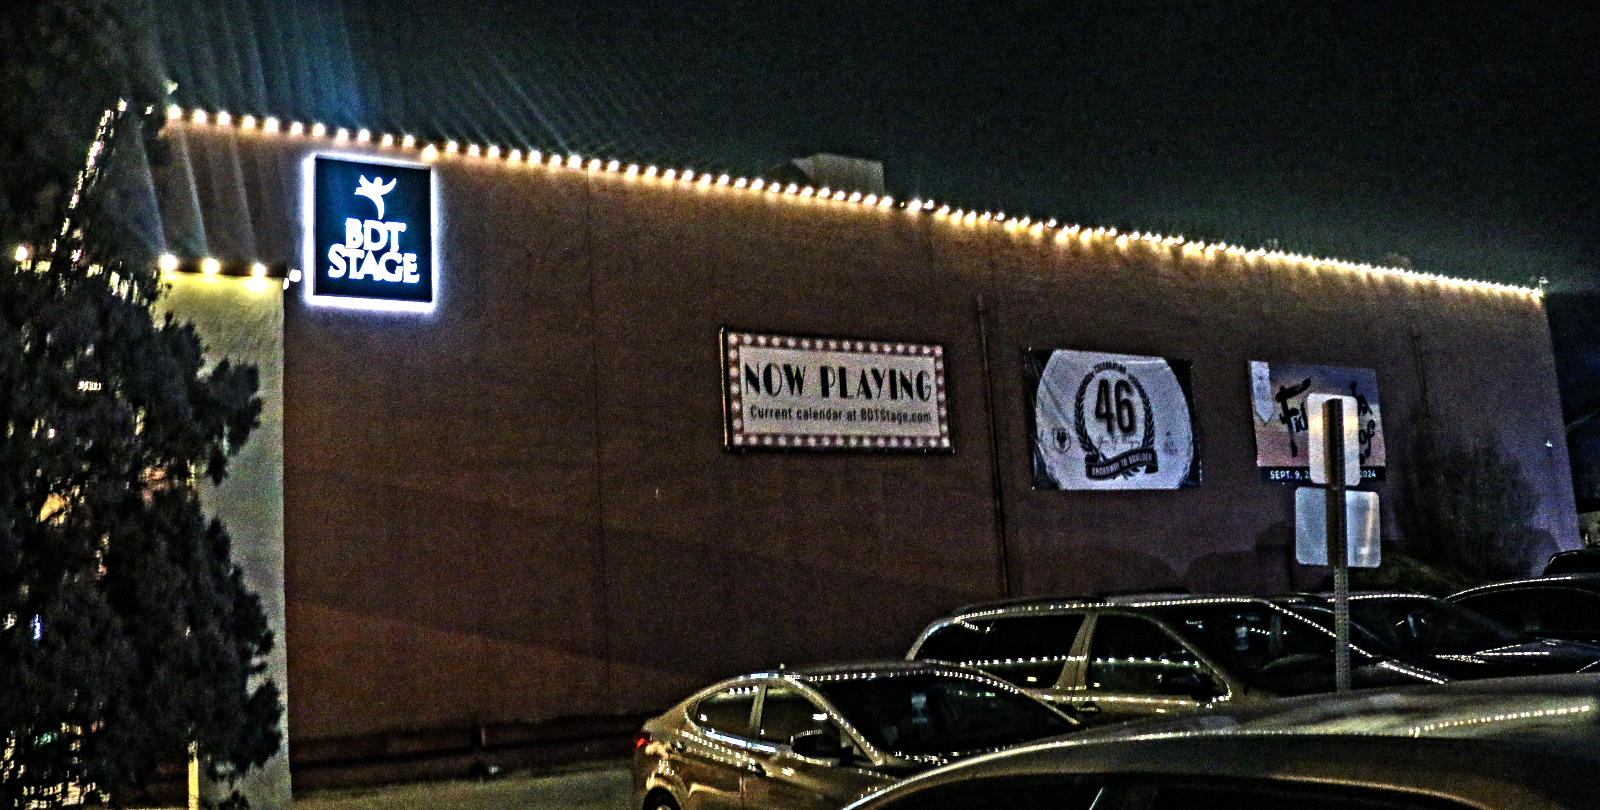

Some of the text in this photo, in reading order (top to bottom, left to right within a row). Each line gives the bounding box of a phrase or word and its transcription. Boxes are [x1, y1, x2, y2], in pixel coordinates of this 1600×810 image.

[345, 217, 407, 252] BDT
[327, 243, 420, 283] STAGE
[744, 361, 932, 402] NOW PLAYING
[750, 404, 932, 425] Current calendar at BDTStage.com
[1095, 379, 1135, 434] 46
[1270, 470, 1293, 480] SEPT.
[1294, 470, 1303, 480] 9,
